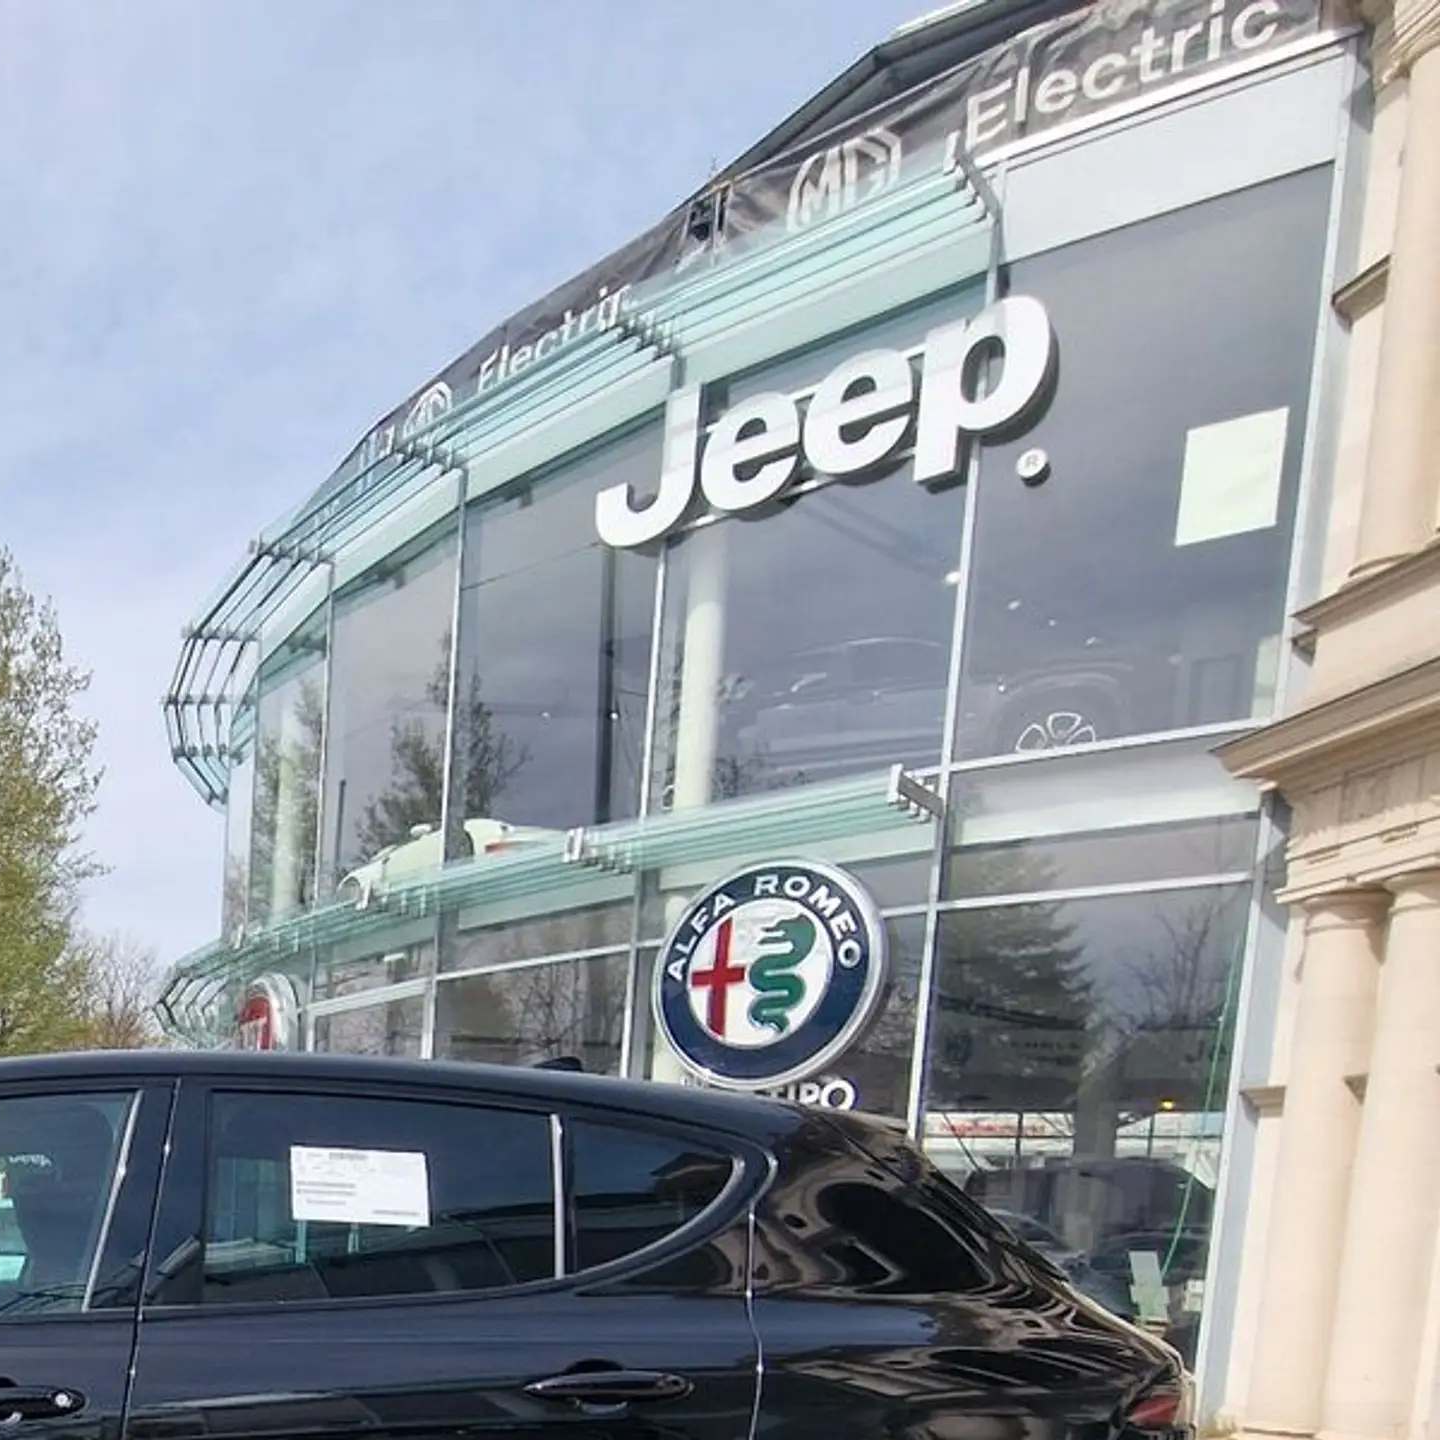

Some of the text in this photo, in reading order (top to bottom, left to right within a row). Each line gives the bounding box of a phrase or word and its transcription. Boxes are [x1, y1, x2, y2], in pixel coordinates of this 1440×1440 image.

[965, 0, 1280, 152] Electric
[596, 295, 1050, 547] Jeep
[667, 873, 861, 982] ALFA ROMEO
